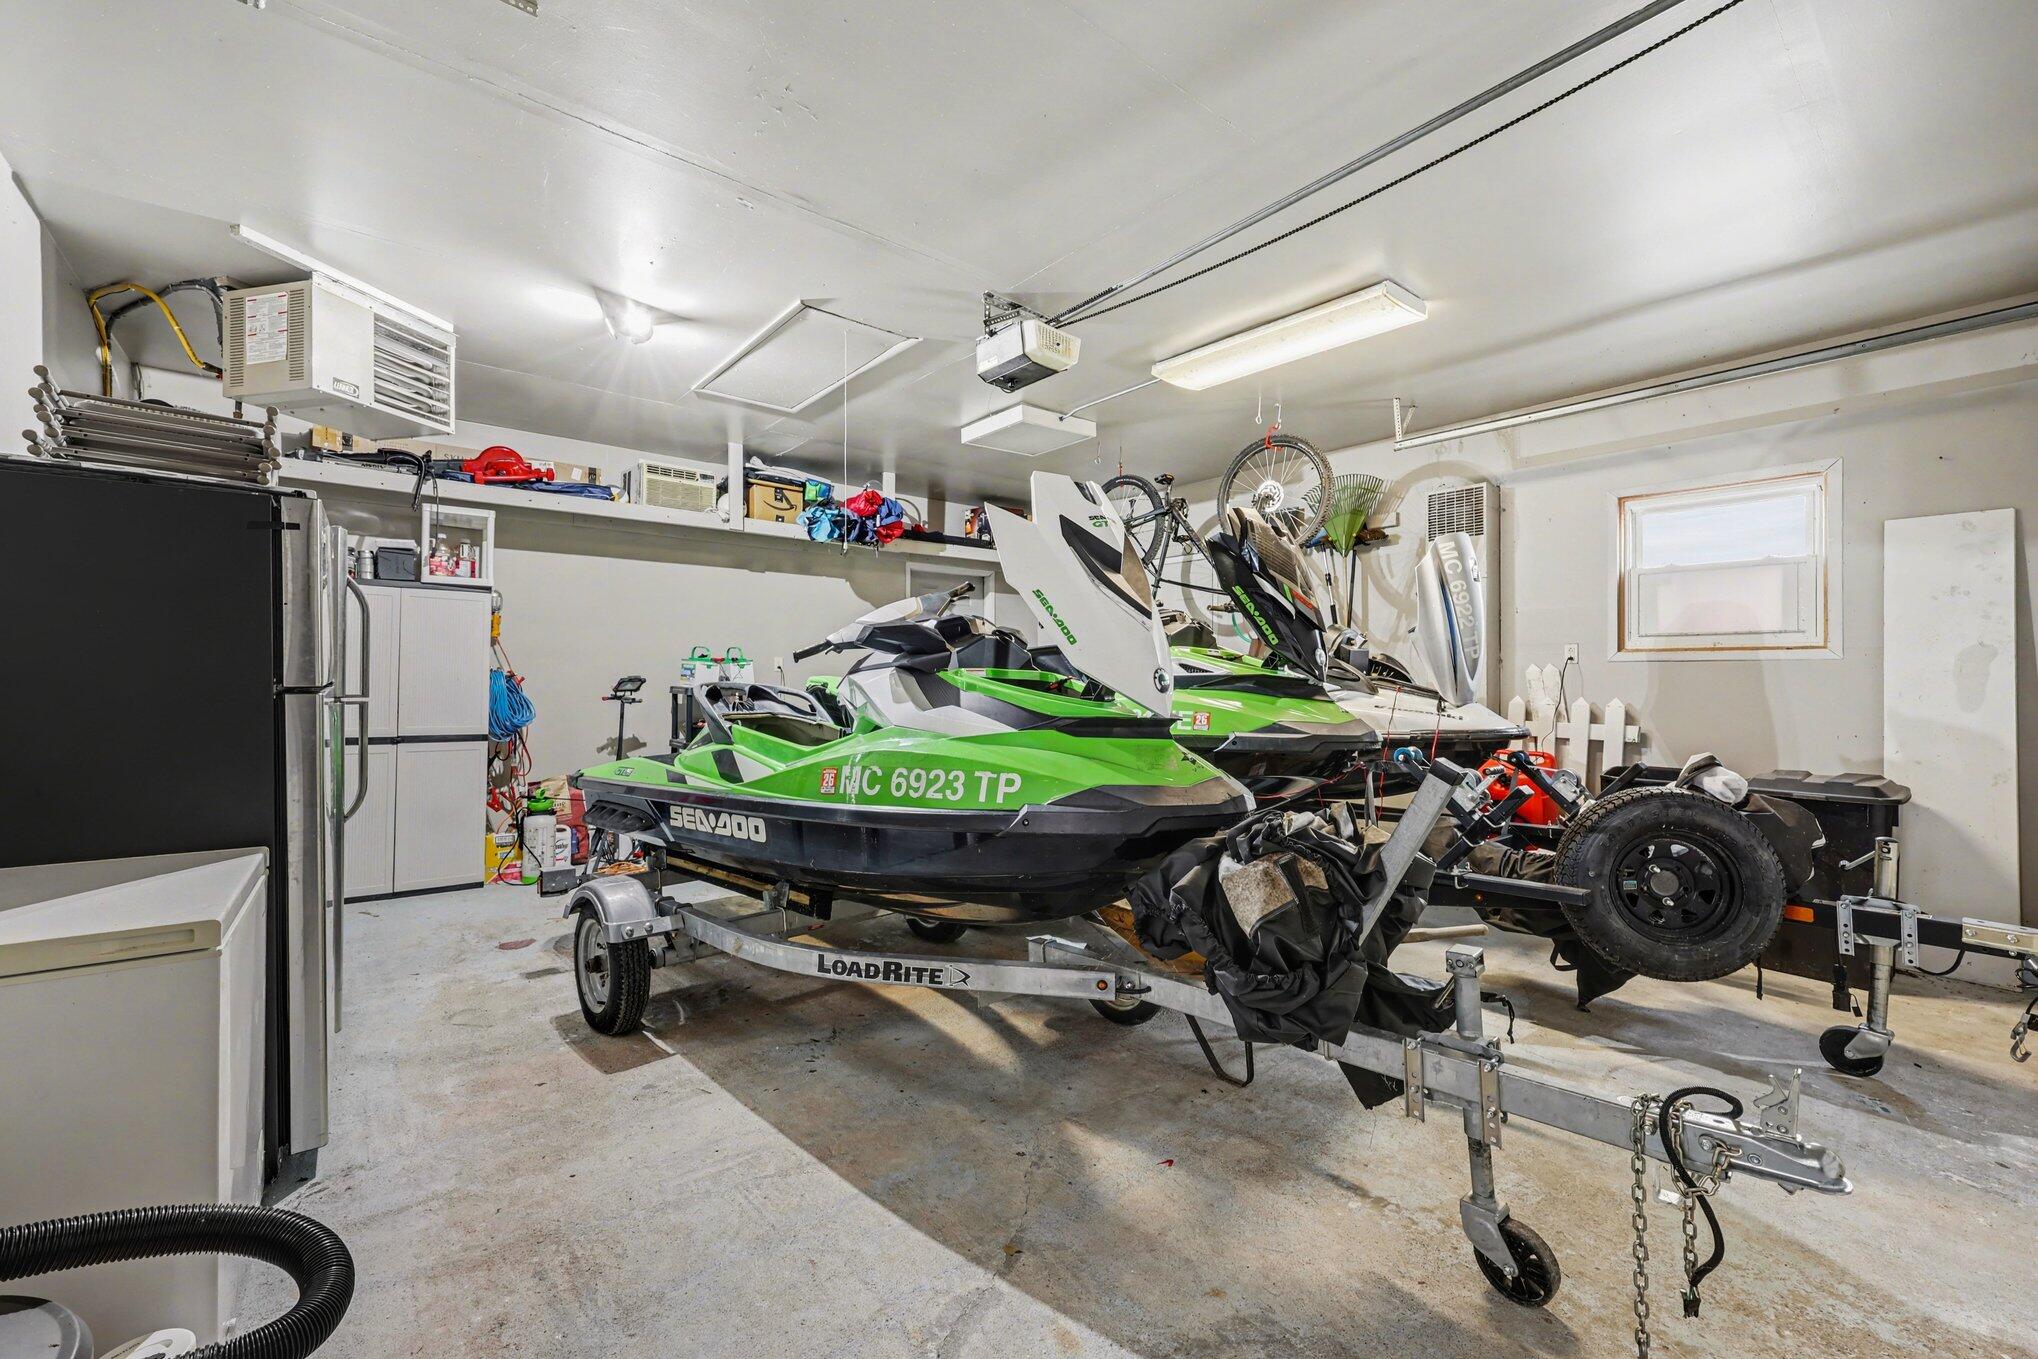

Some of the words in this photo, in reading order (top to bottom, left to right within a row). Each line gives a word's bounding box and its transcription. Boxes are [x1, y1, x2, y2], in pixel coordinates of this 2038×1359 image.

[1438, 541, 1463, 575] MC
[1449, 580, 1475, 629] 6922
[1462, 631, 1480, 659] TP
[1195, 713, 1208, 725] 26
[822, 773, 834, 787] 26
[839, 765, 883, 796] MC
[890, 768, 965, 801] 6923
[974, 770, 1022, 803] TP
[817, 953, 943, 985] LOADRITE
